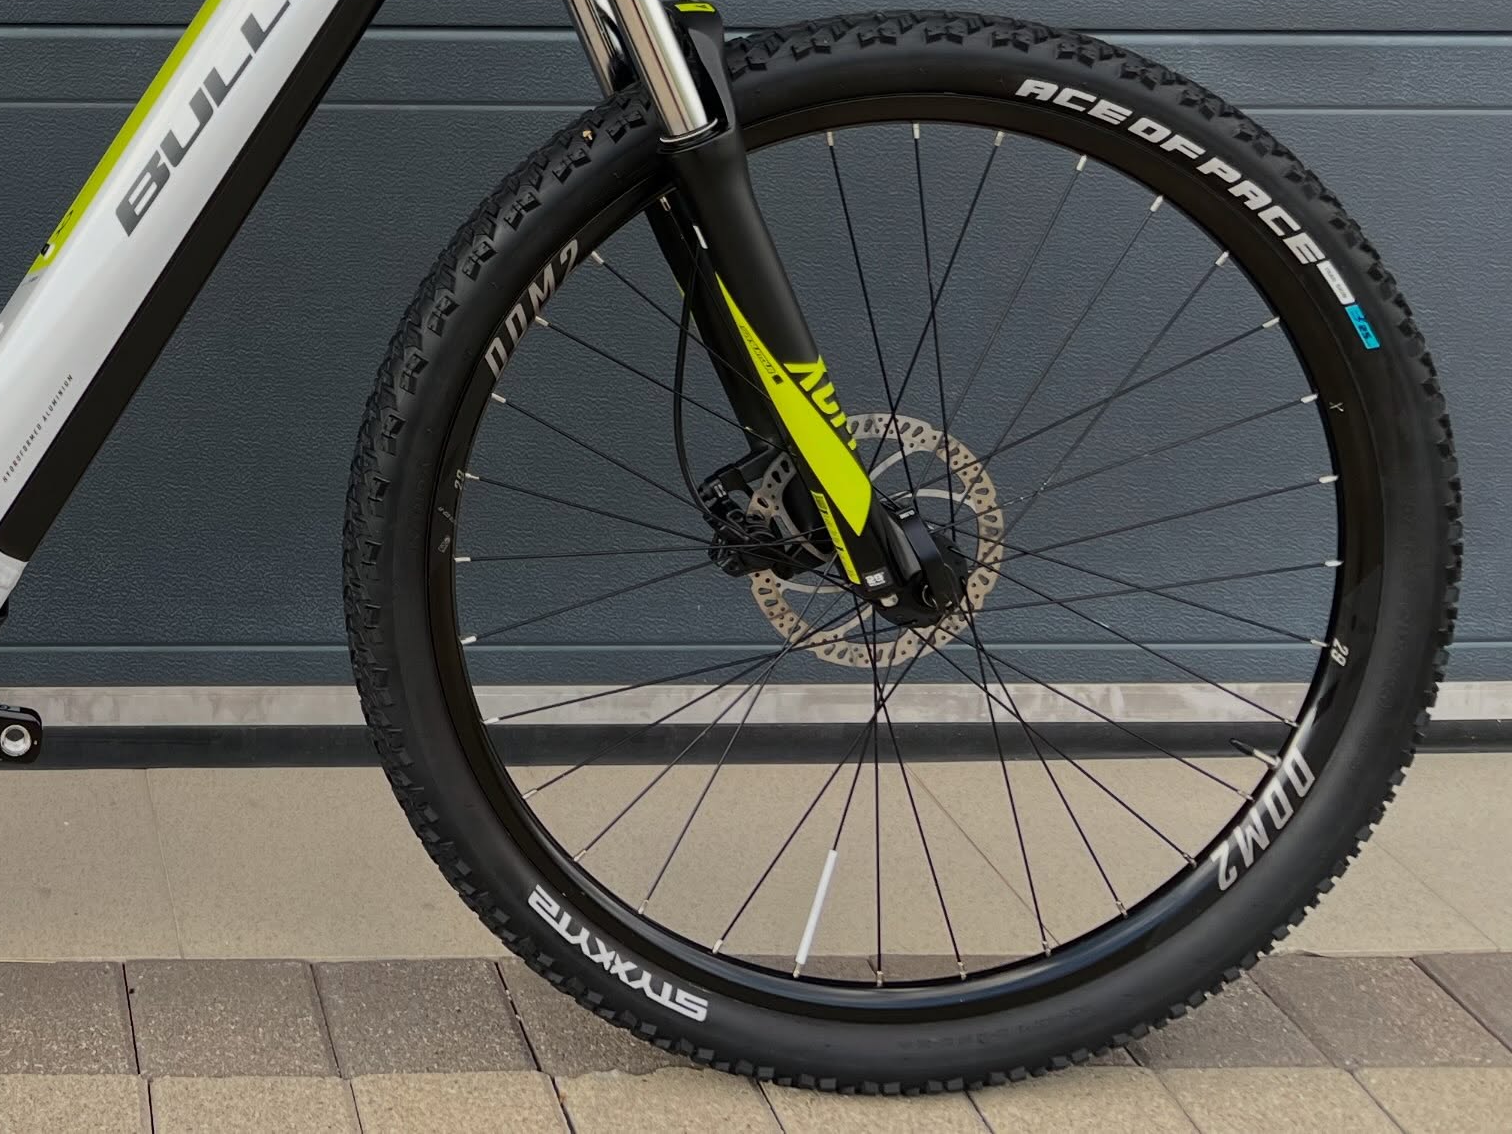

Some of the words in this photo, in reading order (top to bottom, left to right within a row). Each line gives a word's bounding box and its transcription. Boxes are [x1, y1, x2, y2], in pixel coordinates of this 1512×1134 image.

[1015, 78, 1133, 126] ACE
[1127, 116, 1205, 160] OF
[1196, 157, 1326, 265] PACE
[40, 373, 74, 422] ALUMINIUM
[1330, 637, 1349, 667] 29
